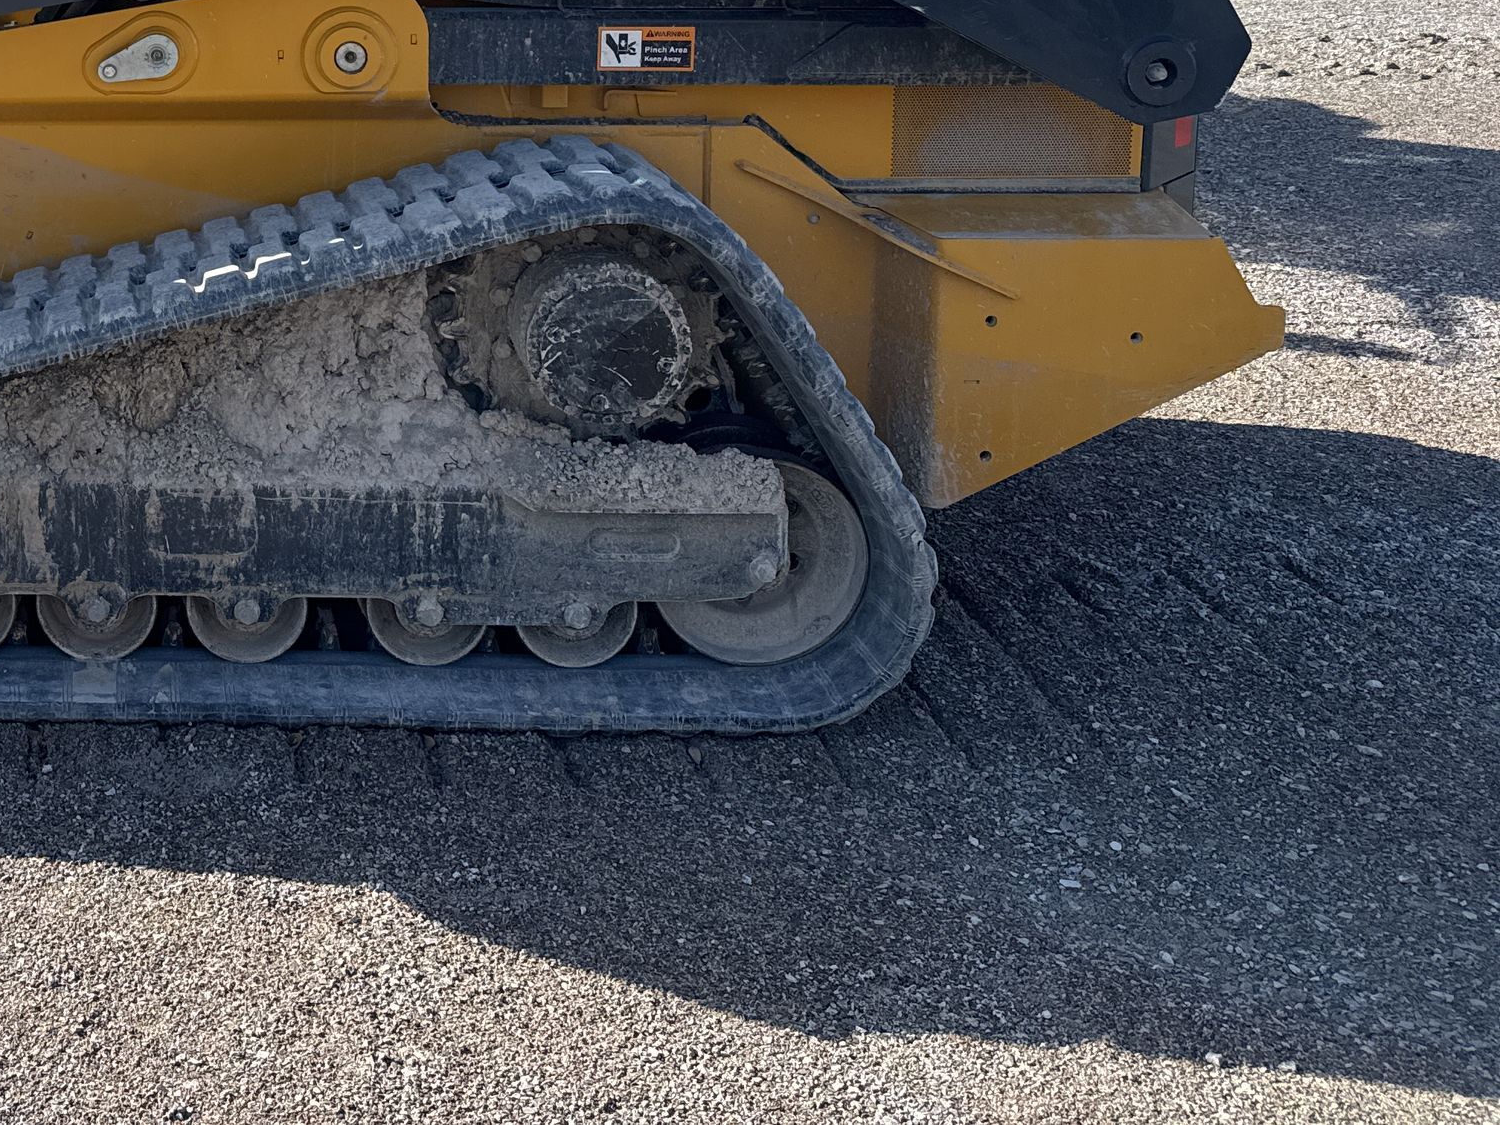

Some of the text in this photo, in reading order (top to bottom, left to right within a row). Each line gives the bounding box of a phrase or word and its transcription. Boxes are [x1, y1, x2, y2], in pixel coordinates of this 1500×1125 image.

[653, 30, 690, 38] WARNING
[644, 46, 688, 54] Pinch Area
[662, 56, 682, 64] Away
